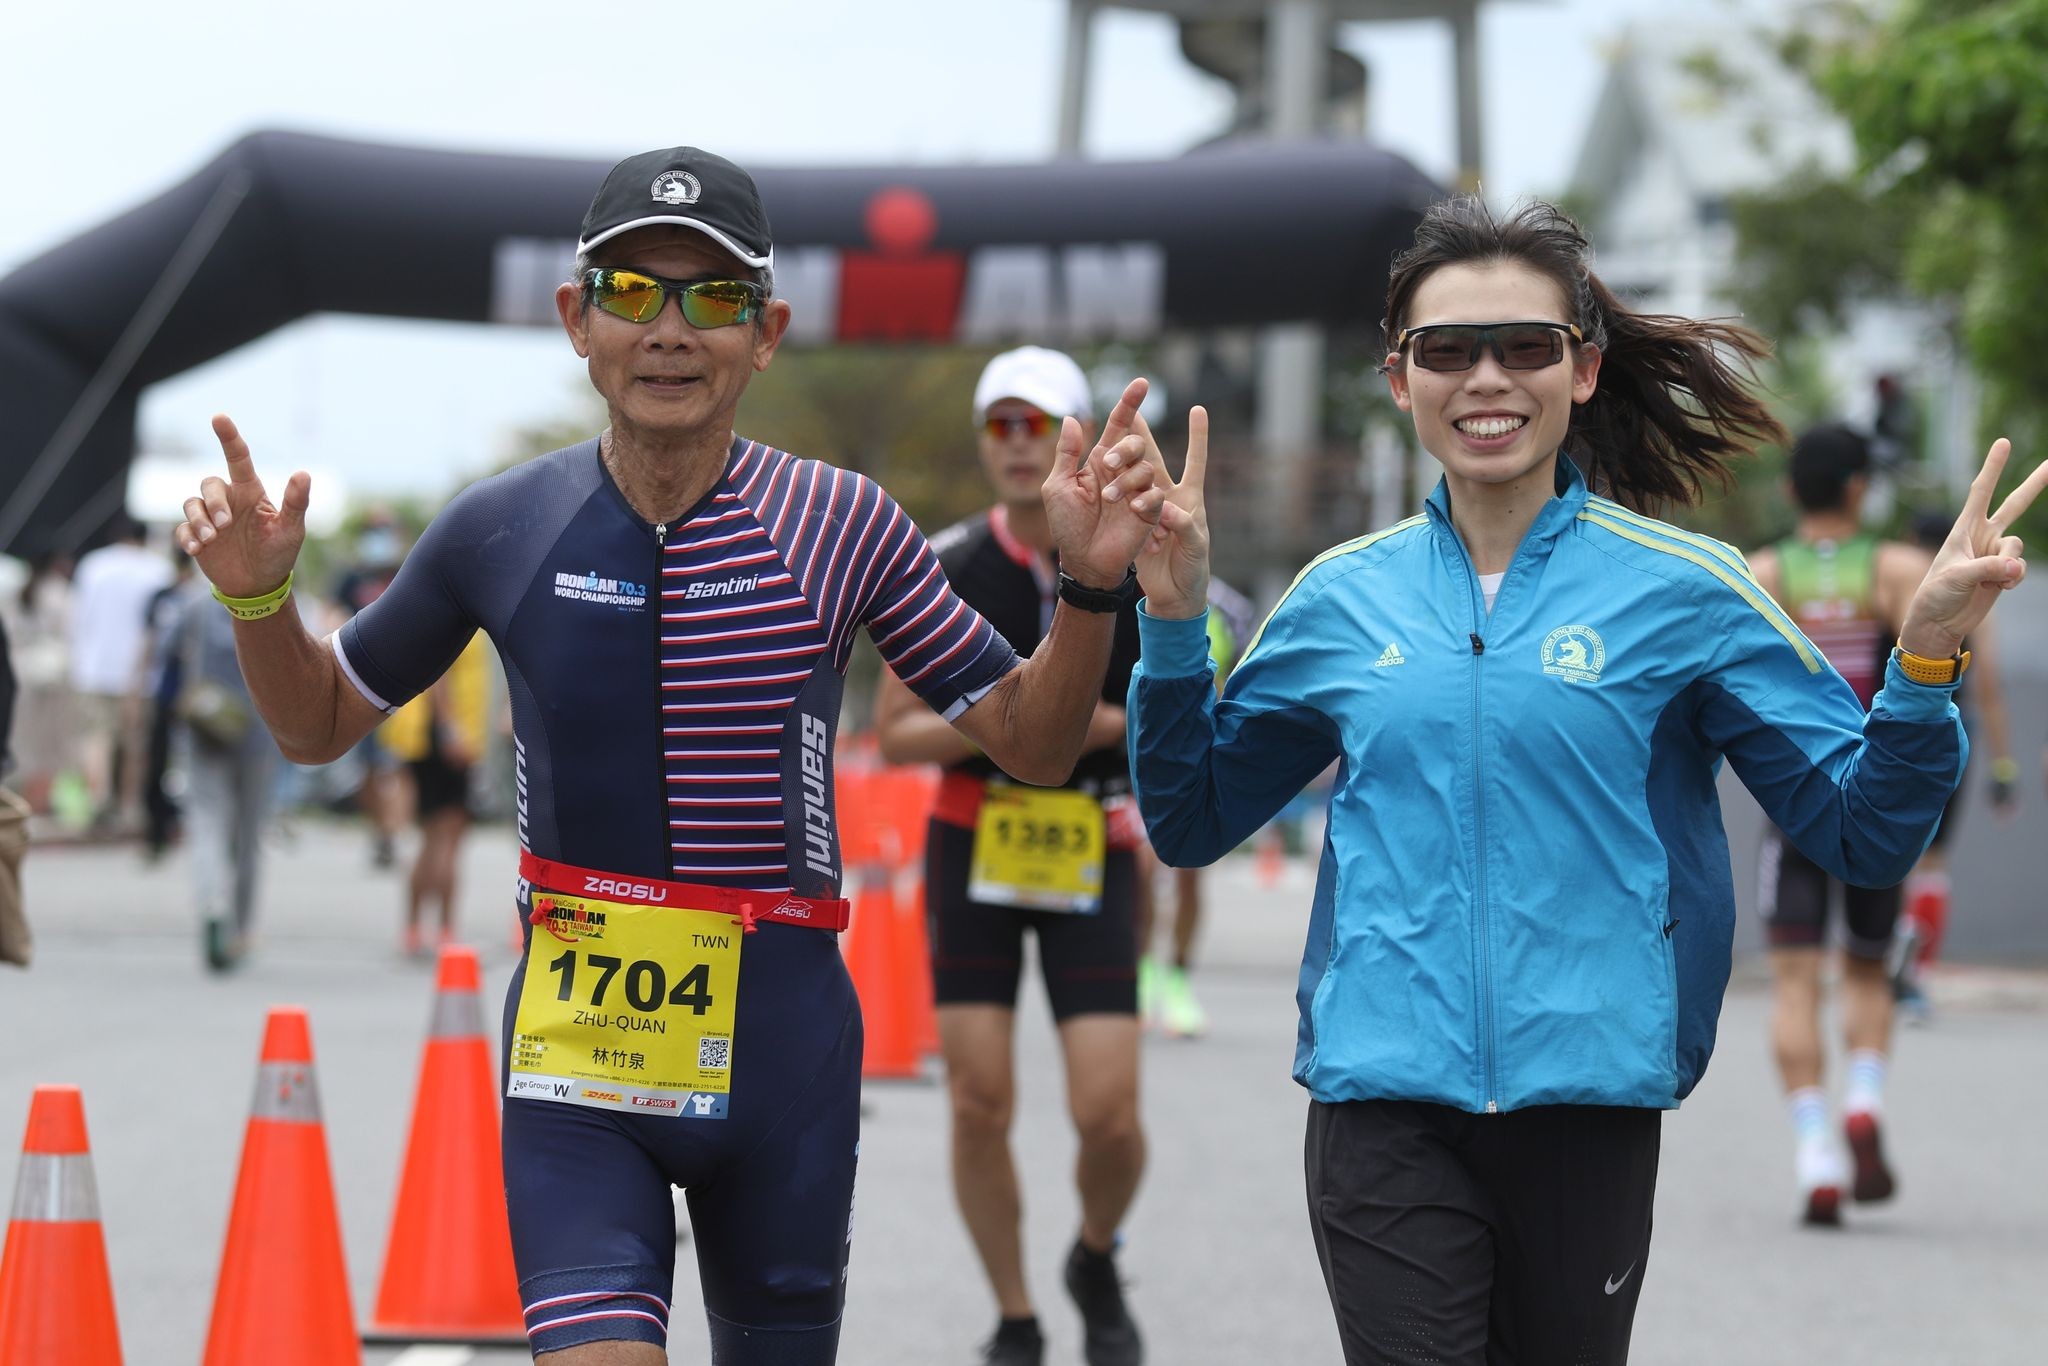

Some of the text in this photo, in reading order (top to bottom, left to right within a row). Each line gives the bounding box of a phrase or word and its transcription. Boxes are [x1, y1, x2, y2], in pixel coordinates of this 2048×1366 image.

[555, 571, 646, 597] IRONMAN 70.3
[685, 573, 759, 600] Santini
[555, 586, 646, 606] WORLD CHAMPIONSHIP
[240, 606, 271, 617] 1704
[1375, 656, 1405, 667] adidas
[801, 712, 839, 880] Santini
[584, 876, 667, 902] ZAOSU
[773, 907, 810, 919] ZAOSU
[570, 921, 594, 932] TAIWAN
[691, 934, 729, 949] TWN
[549, 949, 713, 1016] 1704
[573, 1010, 666, 1035] ZHU-QUAN
[592, 1047, 645, 1070] 林竹泉
[516, 1080, 570, 1097] Age Group: W
[636, 1097, 673, 1108] DT SWISS
